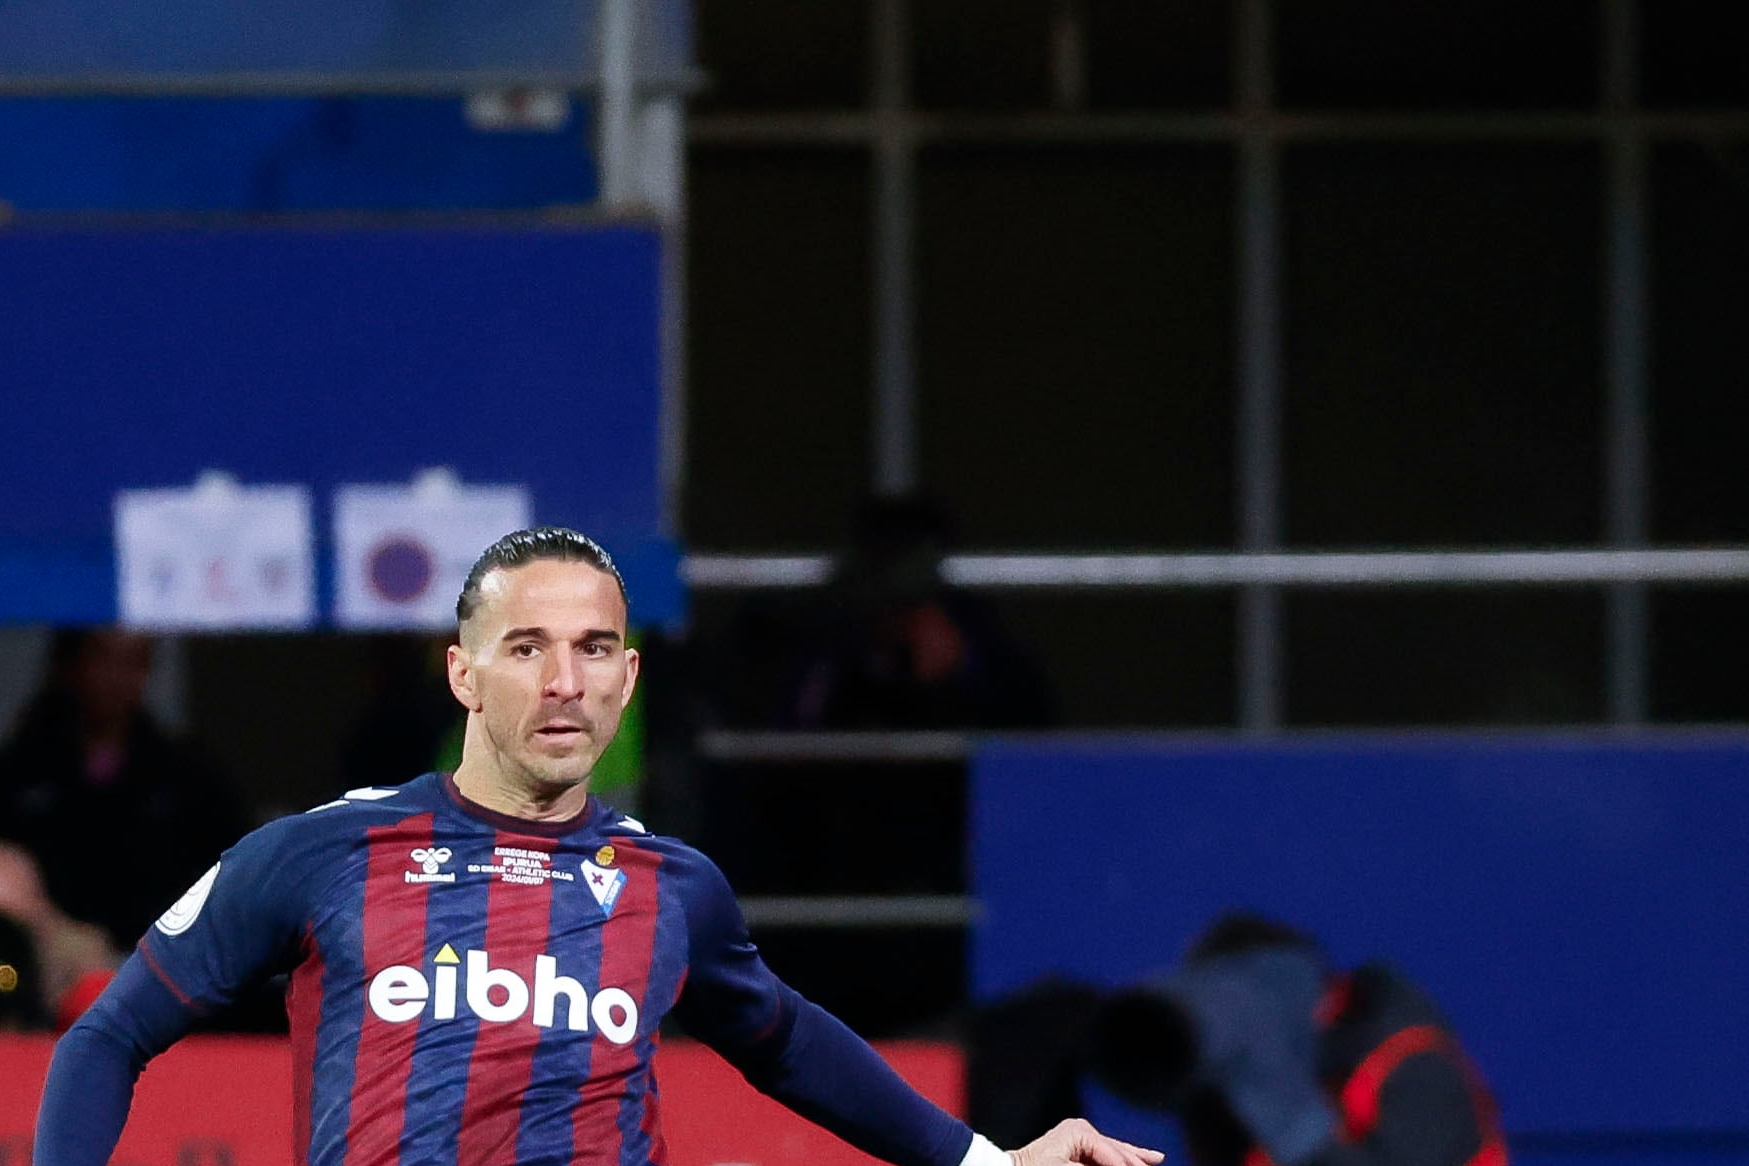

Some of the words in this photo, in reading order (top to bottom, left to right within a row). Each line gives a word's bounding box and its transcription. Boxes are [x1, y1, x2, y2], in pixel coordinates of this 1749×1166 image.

[502, 857, 543, 868] IPURUA
[512, 867, 551, 878] ATHLETIC
[552, 871, 574, 881] CLUB
[368, 942, 639, 1045] eibho
